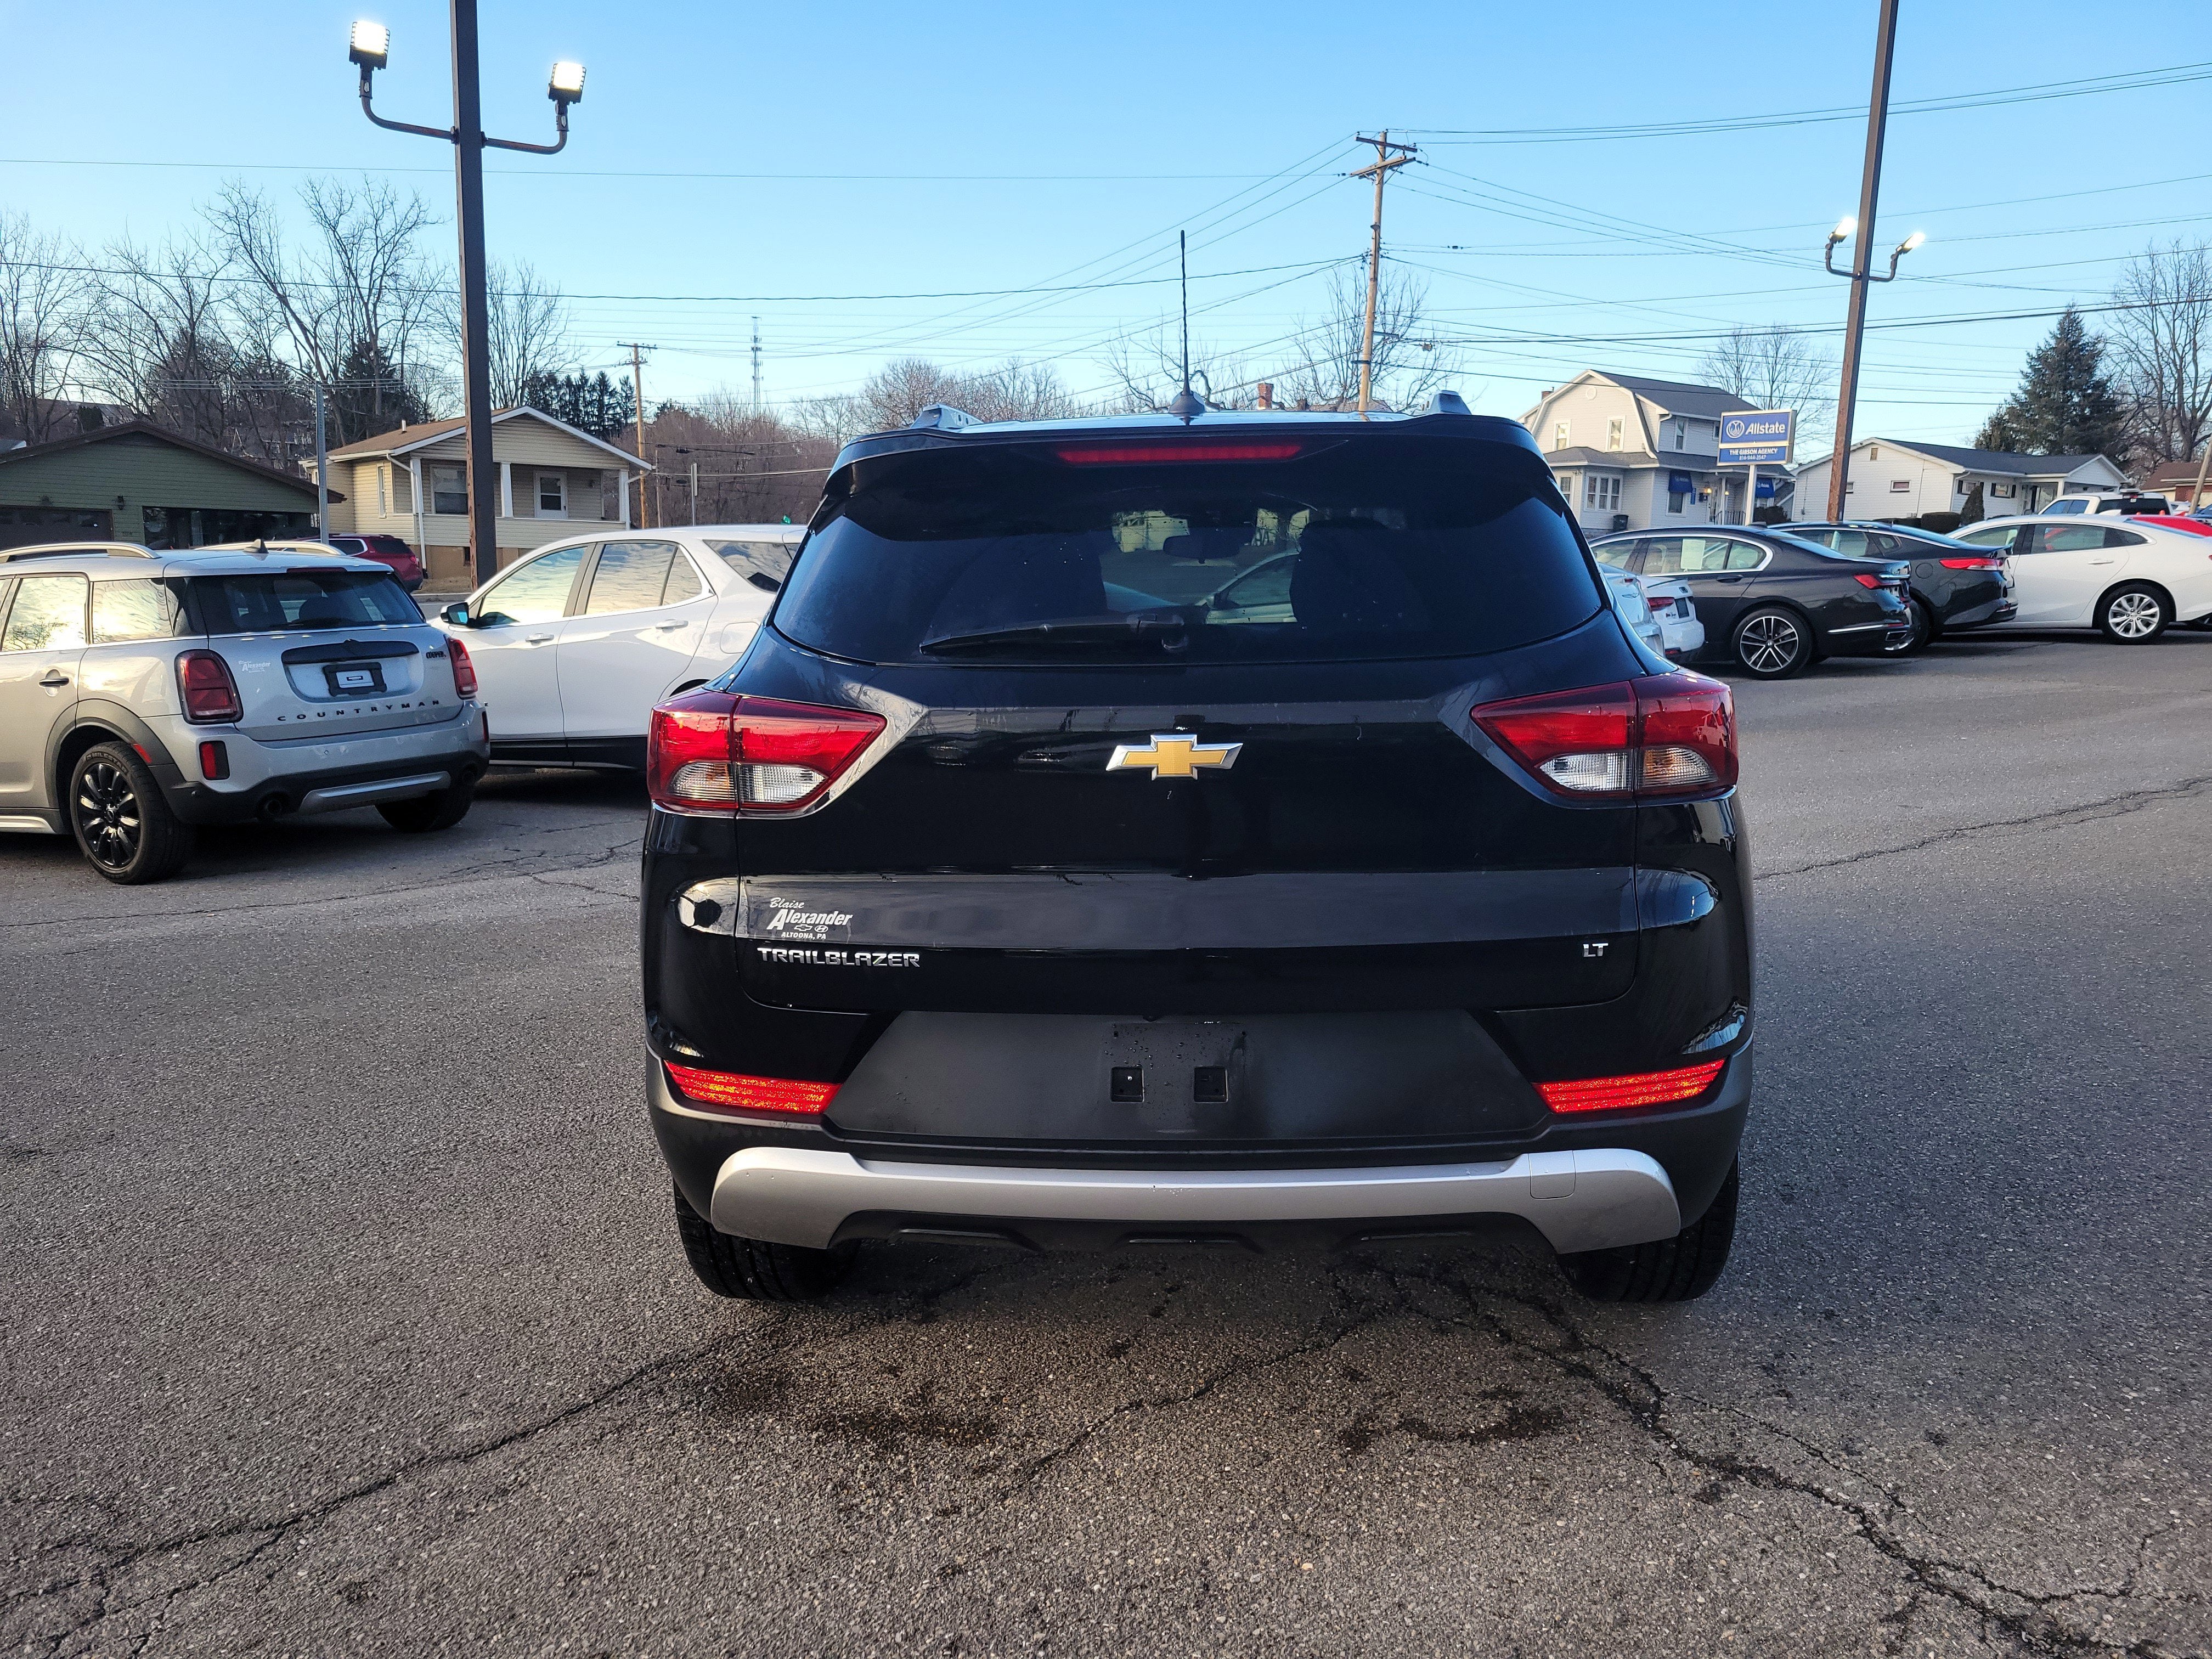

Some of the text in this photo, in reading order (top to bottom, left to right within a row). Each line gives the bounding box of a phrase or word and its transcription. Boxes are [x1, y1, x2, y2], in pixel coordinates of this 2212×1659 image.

[1745, 421, 1785, 435] Allstate
[277, 700, 439, 721] COUNTRYMAN
[769, 897, 805, 909] Blaise
[766, 909, 853, 930] Alexander
[781, 932, 815, 940] ALTOONA,
[757, 947, 920, 967] TRAILBLAZER
[1582, 943, 1609, 957] LT
